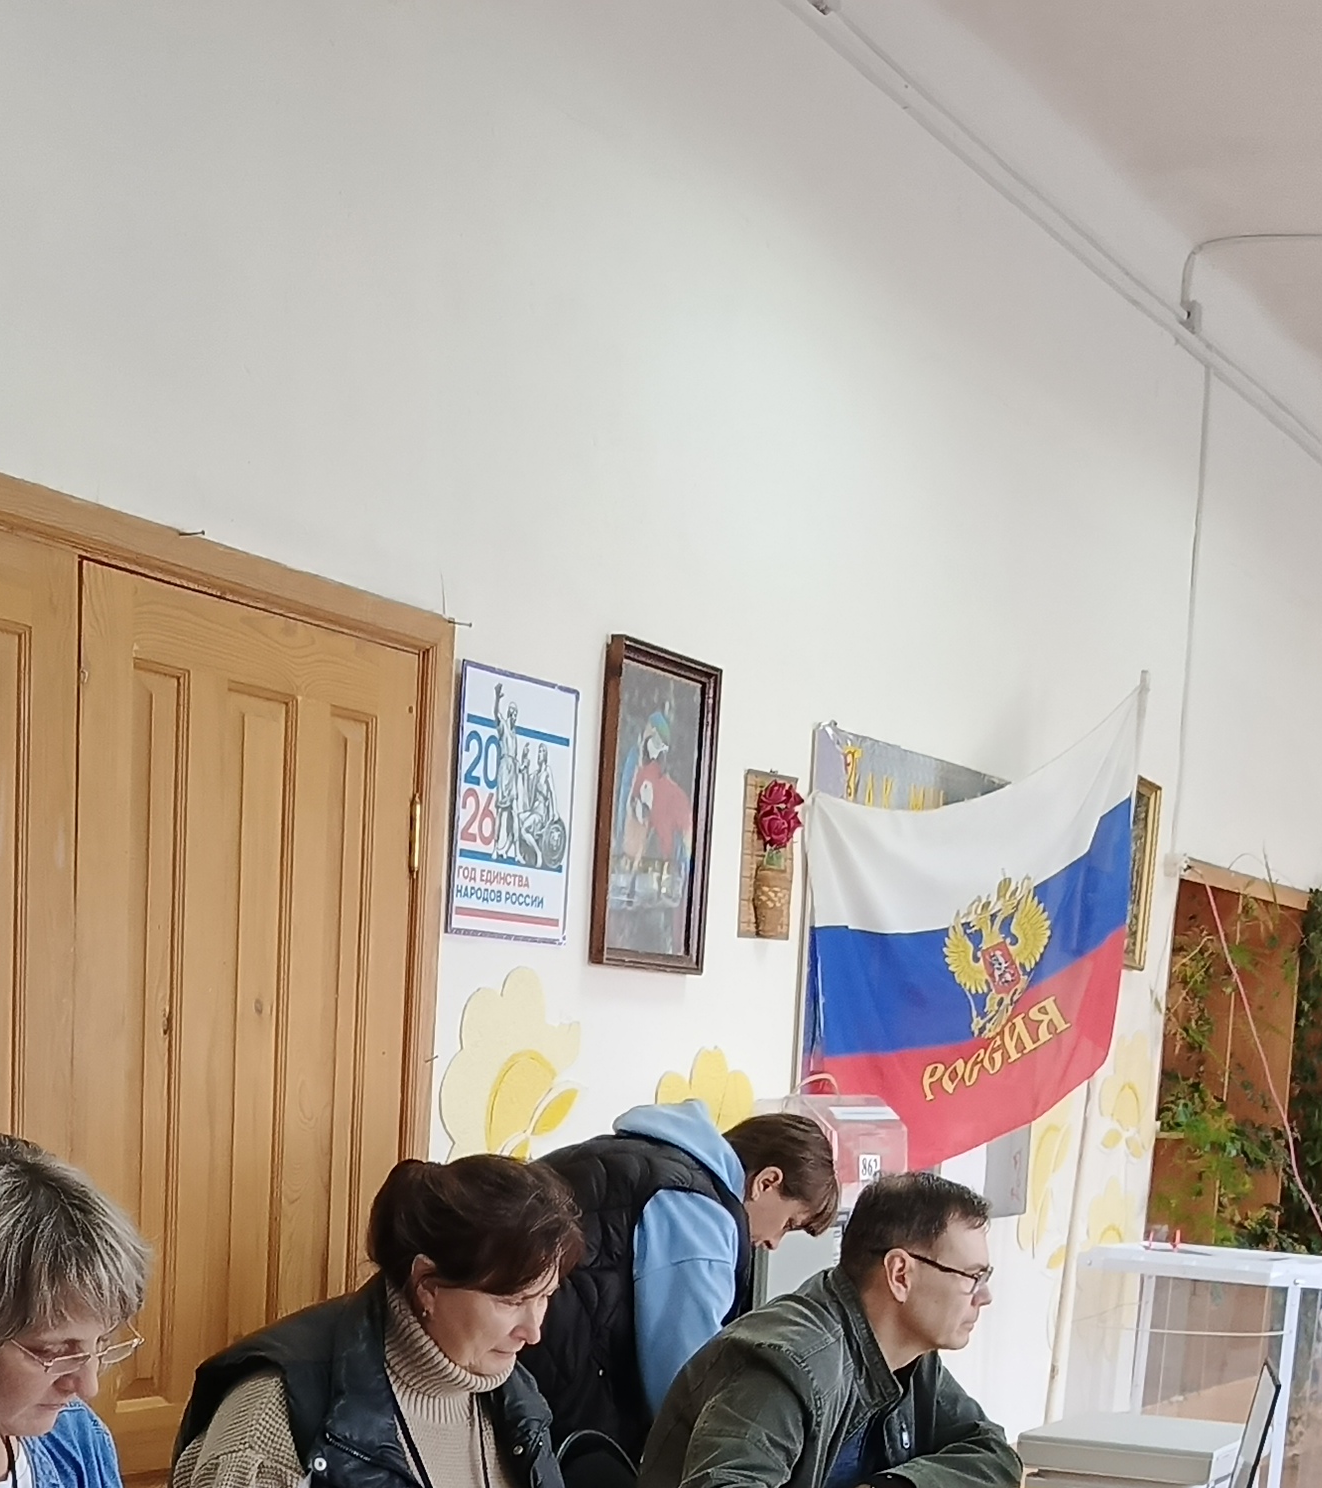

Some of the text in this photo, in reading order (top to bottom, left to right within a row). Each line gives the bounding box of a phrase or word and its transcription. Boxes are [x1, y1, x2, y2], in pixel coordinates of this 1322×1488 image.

[464, 730, 501, 789] 20
[460, 788, 496, 846] 26
[456, 884, 544, 909] НАРОДОВ РОССИИ
[457, 865, 530, 888] ГОД ЕДИНСТВА
[921, 995, 1072, 1102] РОССИЯ
